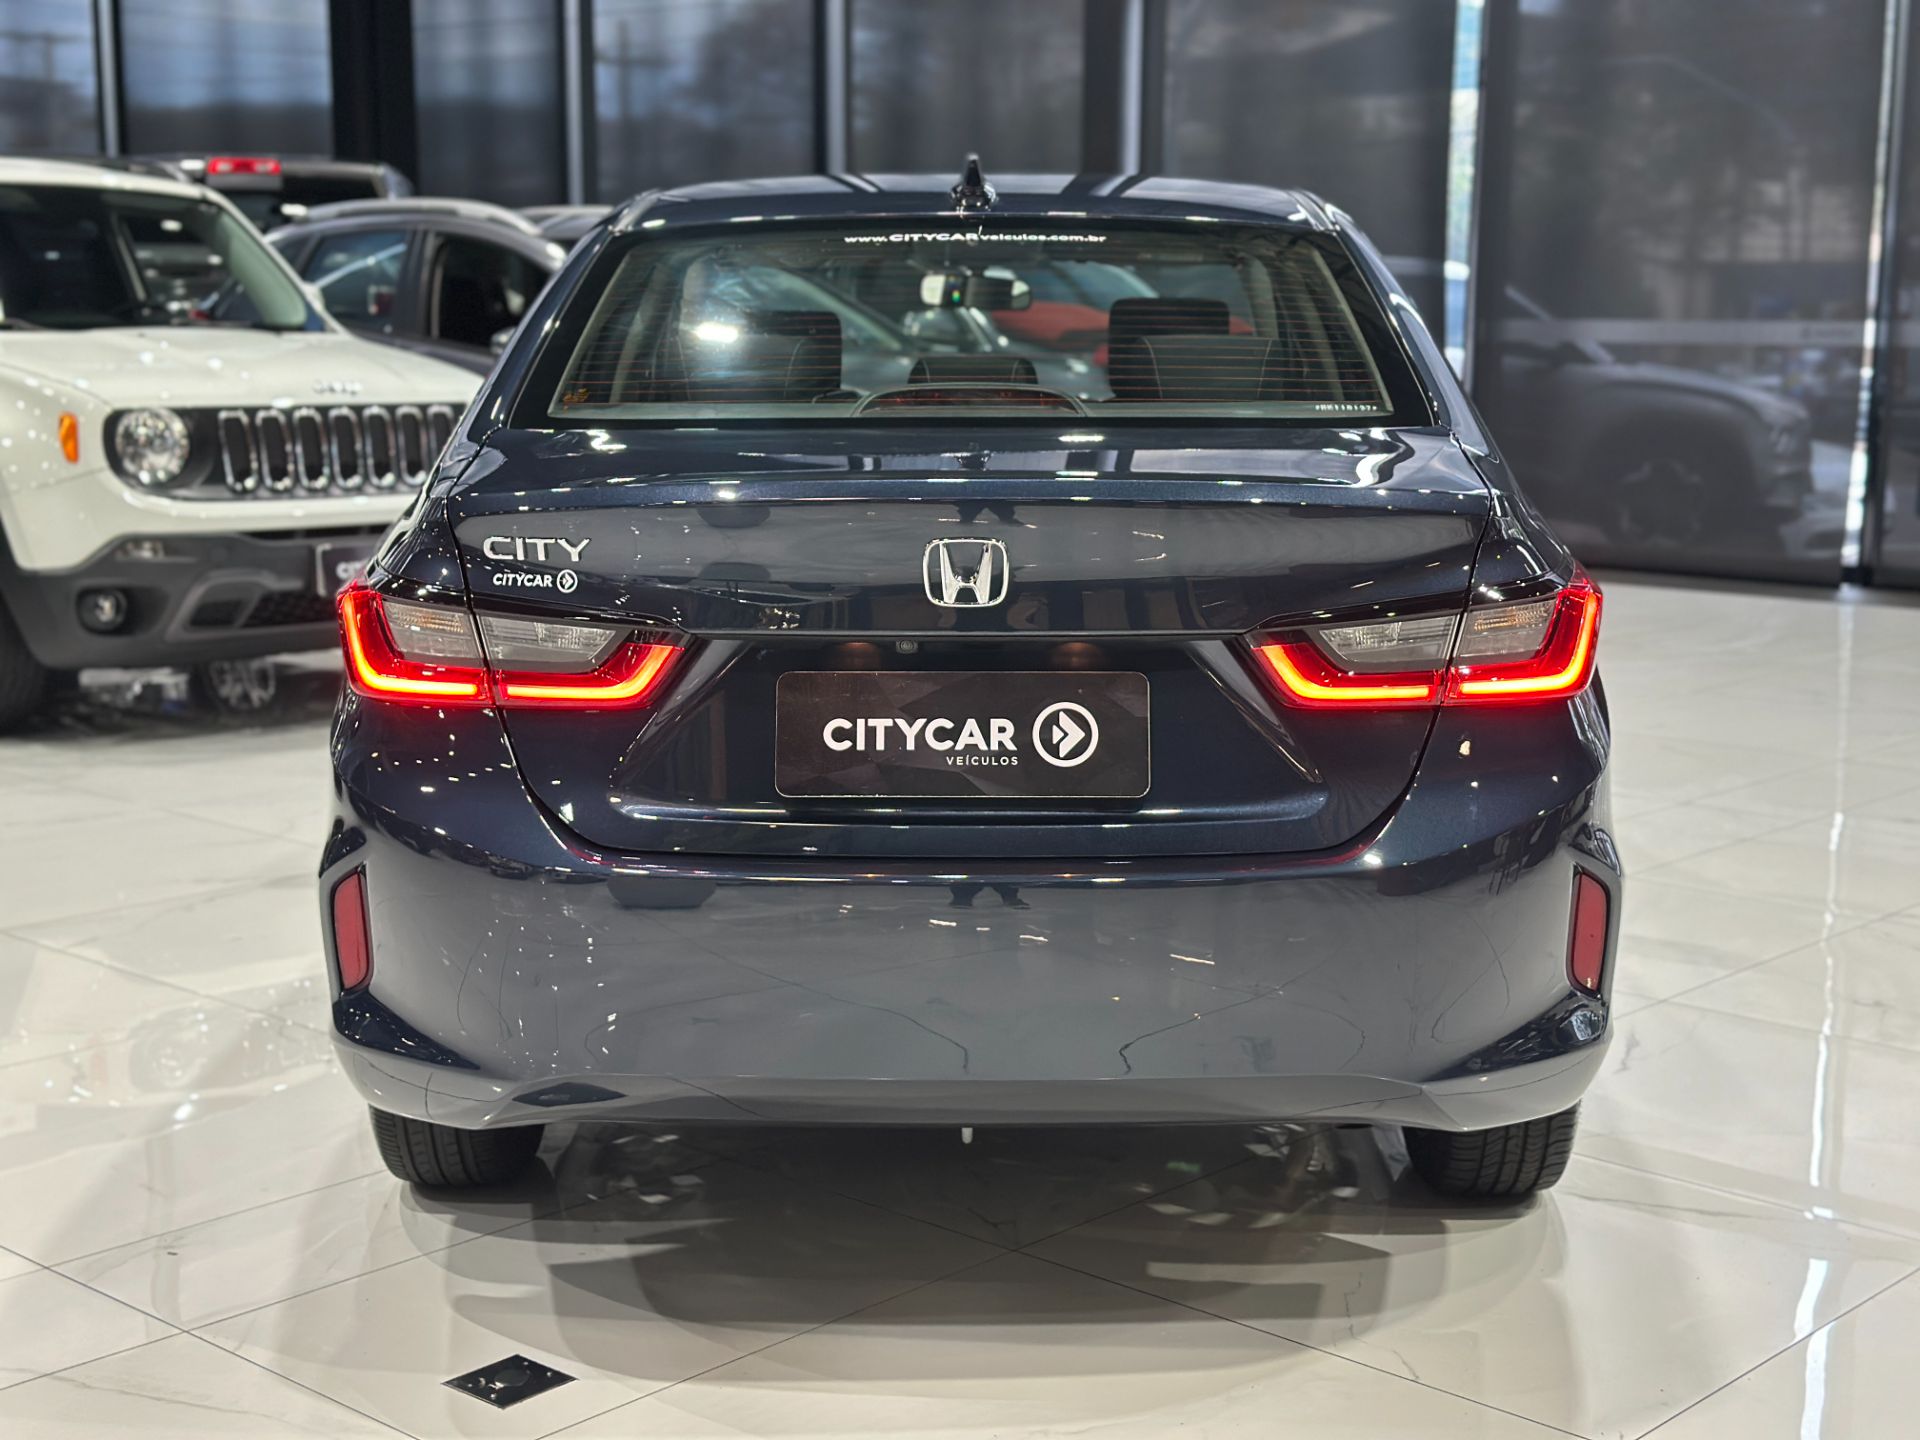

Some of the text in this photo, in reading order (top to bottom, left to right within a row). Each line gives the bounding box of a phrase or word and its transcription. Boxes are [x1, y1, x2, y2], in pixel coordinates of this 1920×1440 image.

[483, 536, 590, 562] CITY
[492, 573, 553, 588] CITYCAR
[823, 718, 1018, 751] CITYCAR
[946, 754, 1019, 766] VEÍCULOS
